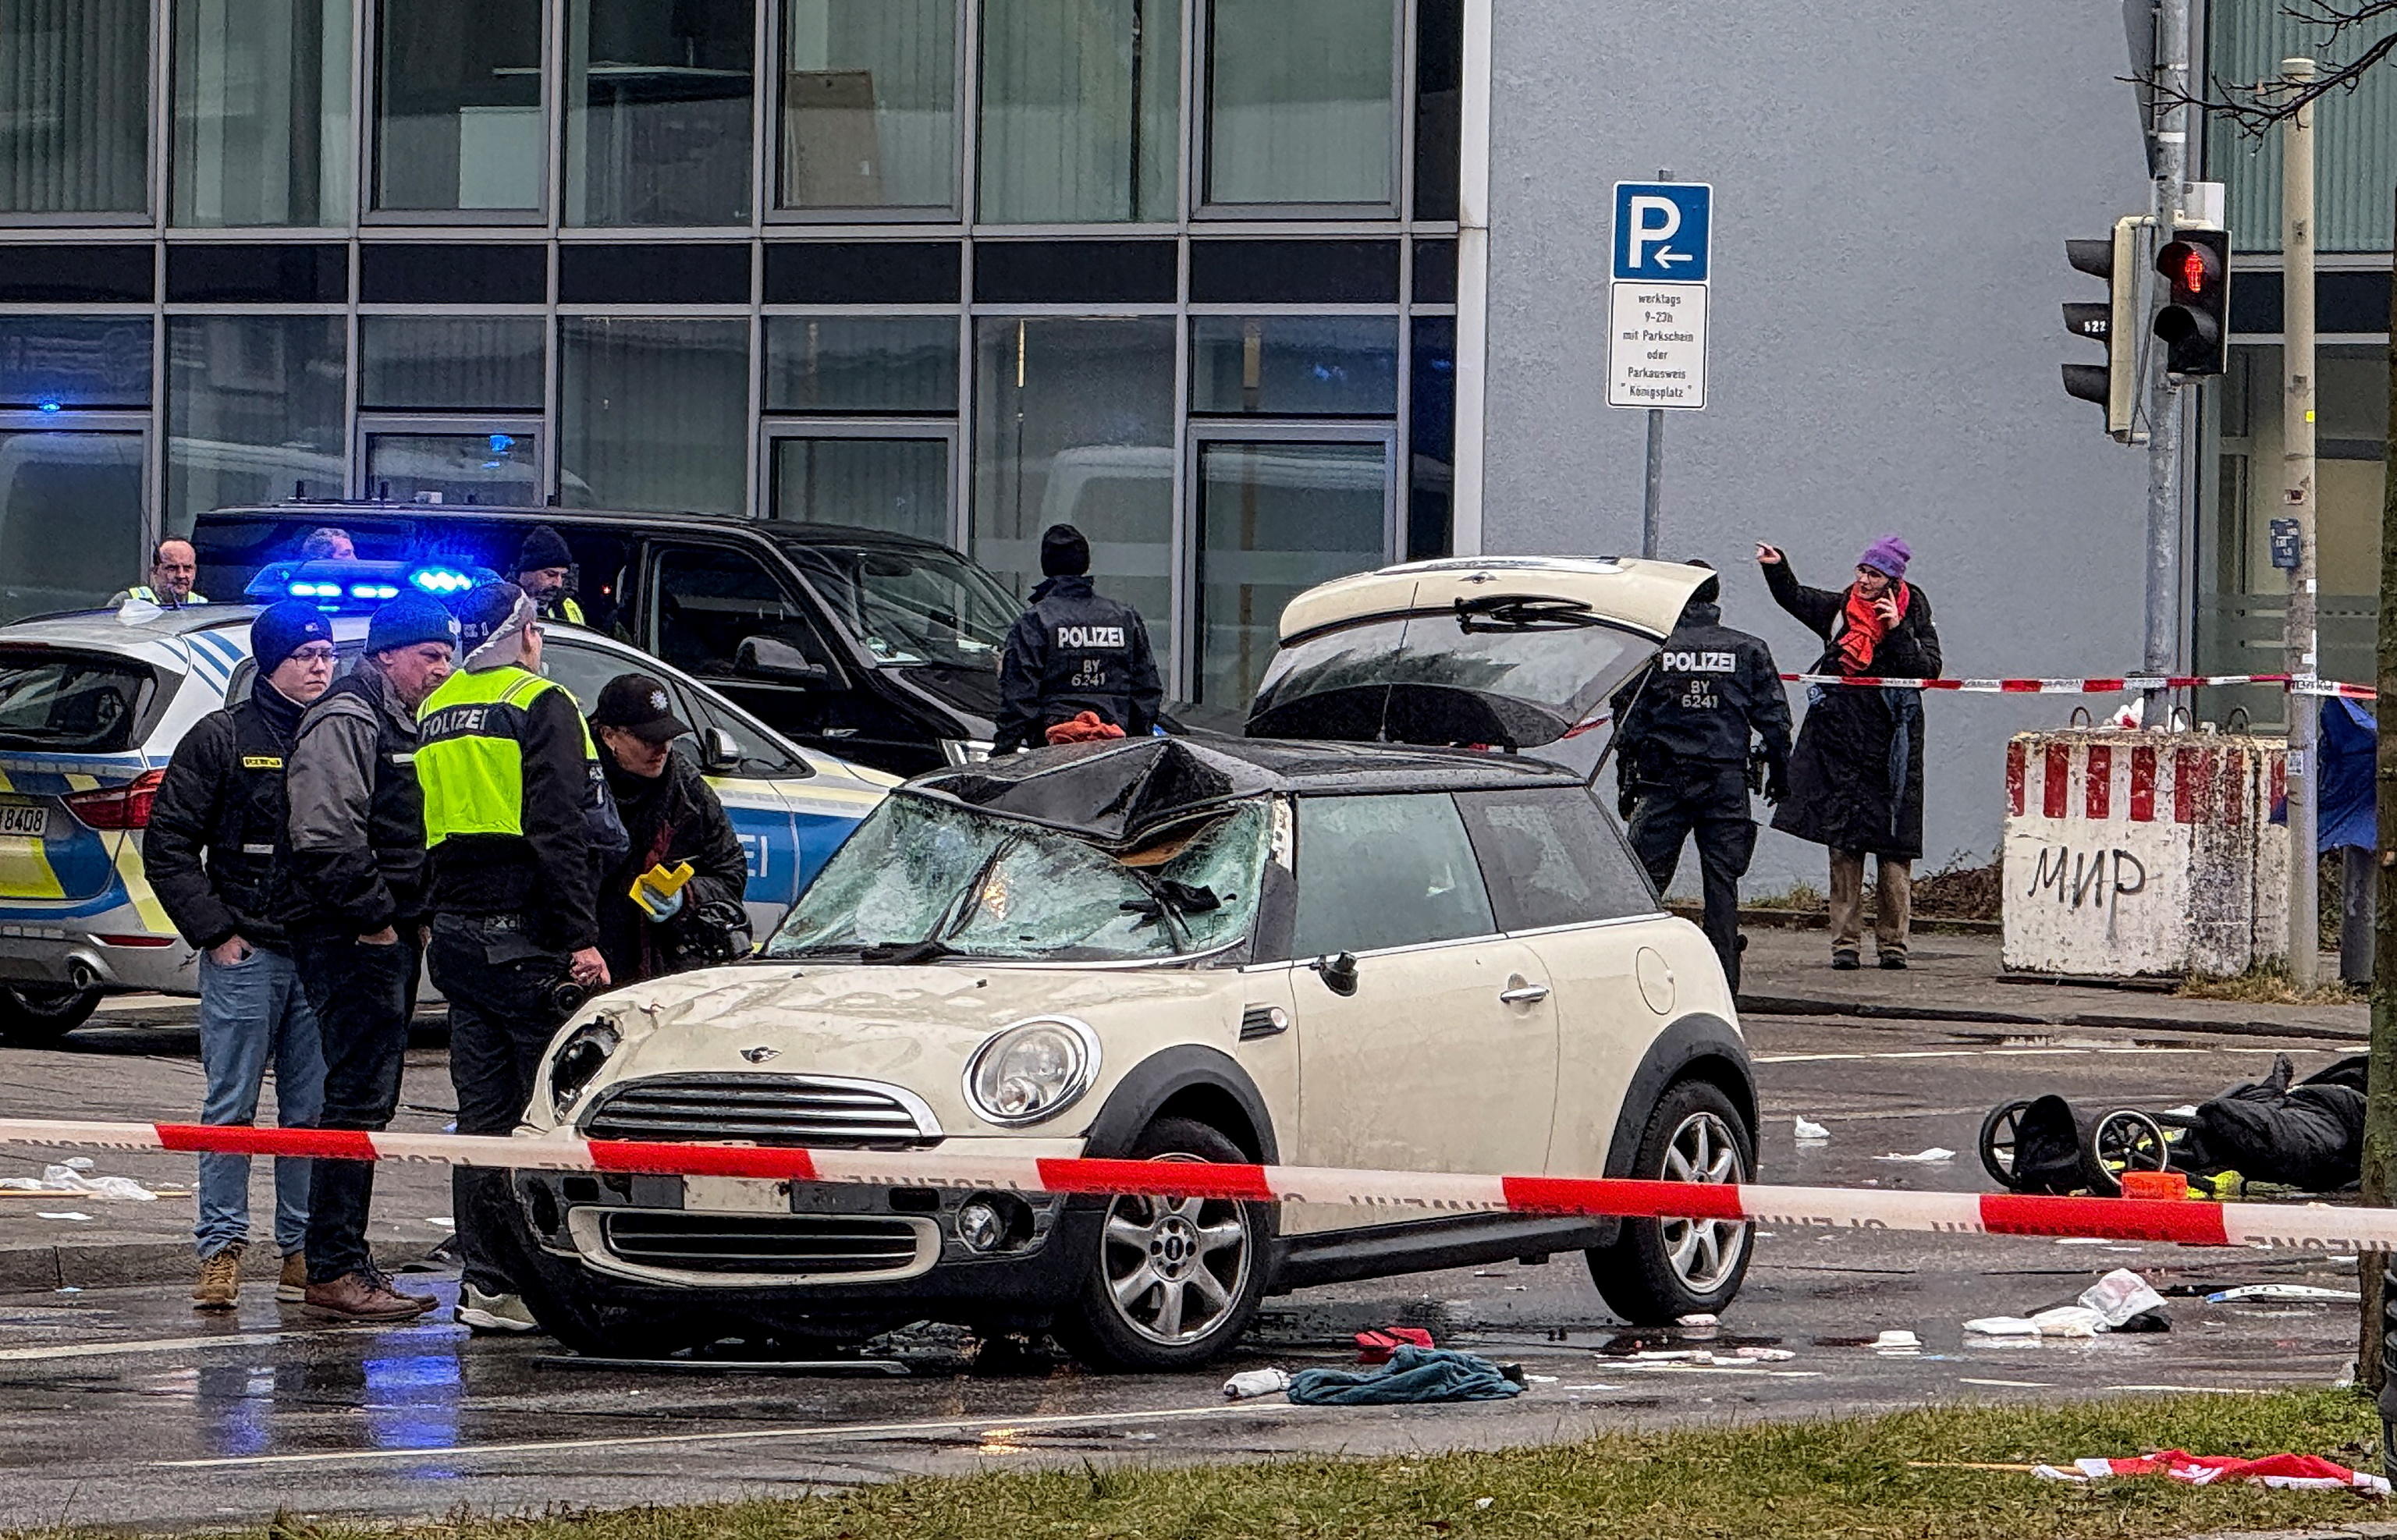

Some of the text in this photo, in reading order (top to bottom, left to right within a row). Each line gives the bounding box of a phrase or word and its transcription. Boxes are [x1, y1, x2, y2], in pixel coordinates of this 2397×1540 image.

[1629, 196, 1681, 268] P
[1639, 293, 1681, 307] werktags
[1645, 310, 1674, 323] 9-23h
[1623, 330, 1693, 342] mit Parkschein
[1647, 350, 1668, 360] oder
[1628, 367, 1686, 379] Parkausweis
[1057, 626, 1125, 648] POLIZEI
[1083, 659, 1100, 673] BY
[1662, 651, 1736, 672] POLIZEI
[1071, 672, 1106, 687] 6241
[1690, 680, 1710, 694] BY
[1682, 694, 1719, 708] 6241
[421, 708, 488, 743] POLIZEI
[2029, 846, 2146, 936] МИР
